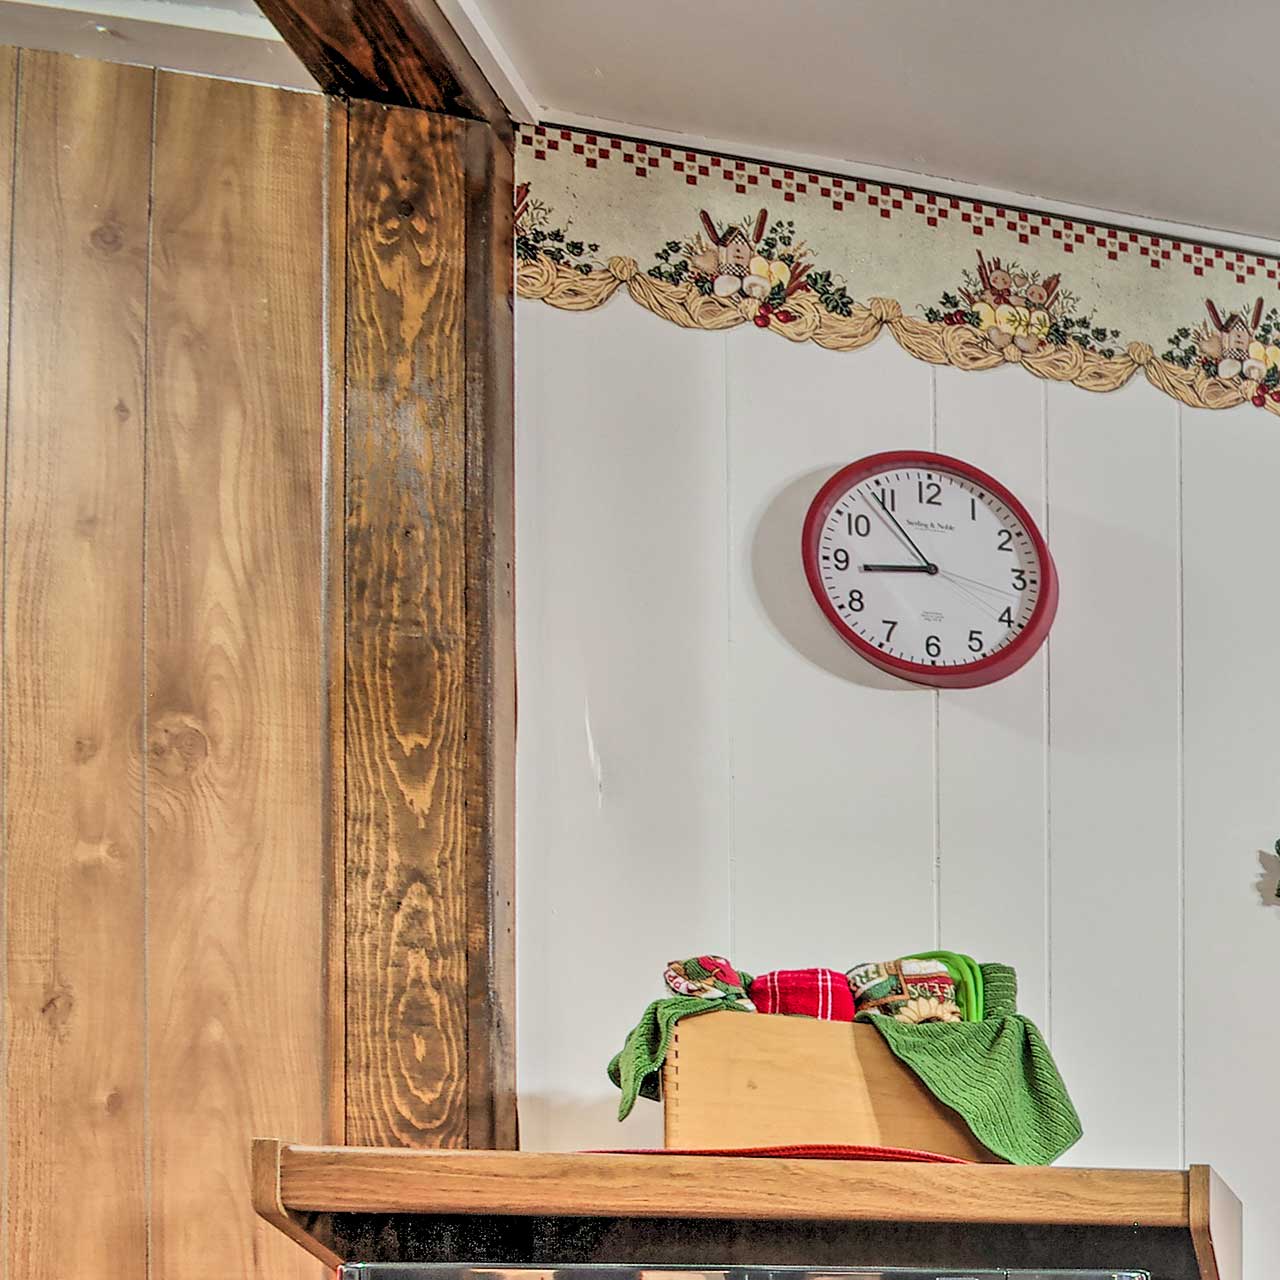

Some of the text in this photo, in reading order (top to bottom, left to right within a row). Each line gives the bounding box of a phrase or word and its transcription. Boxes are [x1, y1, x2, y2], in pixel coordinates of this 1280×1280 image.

[880, 488, 896, 512] 11
[918, 481, 942, 506] 12
[970, 498, 977, 521] 1
[847, 512, 870, 538] 10
[997, 529, 1013, 552] 2
[833, 548, 849, 571] 9
[1011, 568, 1027, 591] 3
[848, 589, 864, 612] 8
[998, 606, 1014, 628] 4
[882, 620, 898, 642] 7
[968, 630, 983, 652] 5
[926, 635, 941, 658] 6
